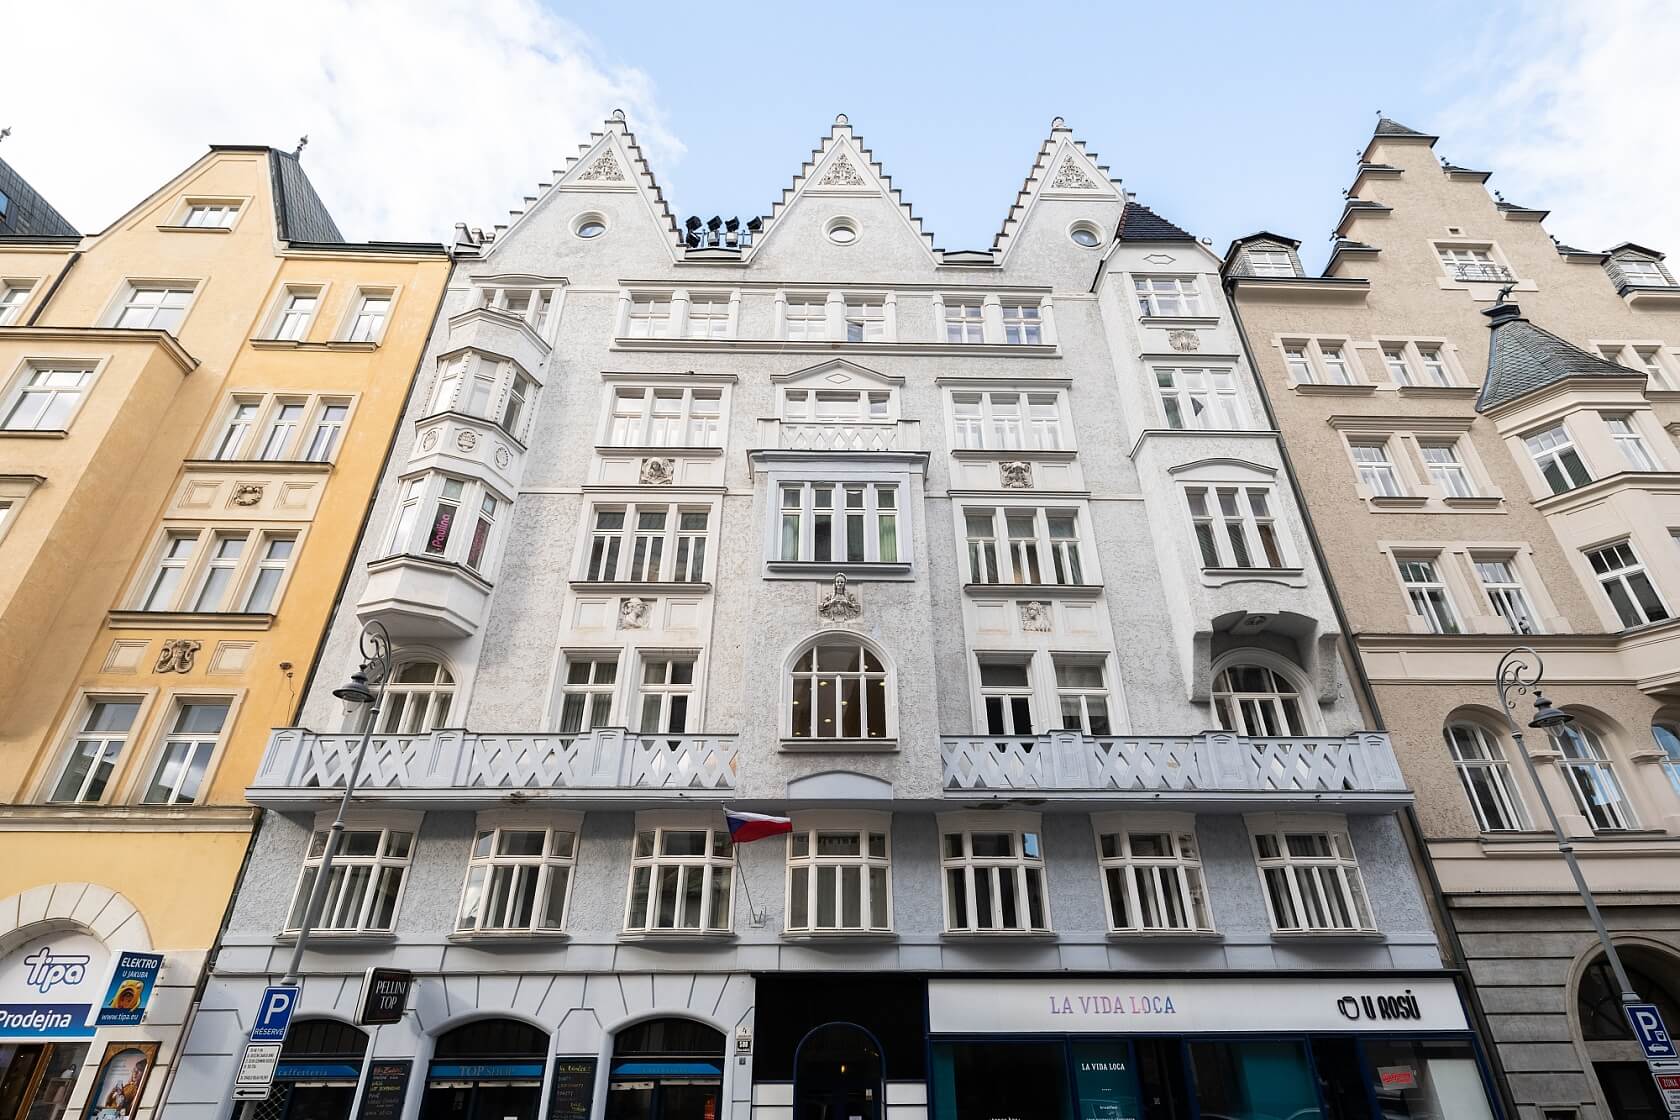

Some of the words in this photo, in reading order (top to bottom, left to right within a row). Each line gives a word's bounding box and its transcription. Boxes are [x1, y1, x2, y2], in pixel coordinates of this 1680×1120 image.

[24, 947, 90, 993] tipa
[121, 957, 158, 969] ELEKTRO
[264, 994, 290, 1025] P
[380, 995, 398, 1009] TOP
[1050, 996, 1074, 1015] LA
[1078, 996, 1126, 1015] VIDA
[1131, 996, 1177, 1015] LOCA
[1361, 995, 1377, 1020] U
[0, 1009, 73, 1032] Prodejna
[101, 1012, 139, 1022] www.tipa.eu
[1635, 1011, 1658, 1041] P
[1081, 1063, 1091, 1071] LA
[1091, 1063, 1108, 1071] VIDA
[1109, 1063, 1125, 1071] LOCA
